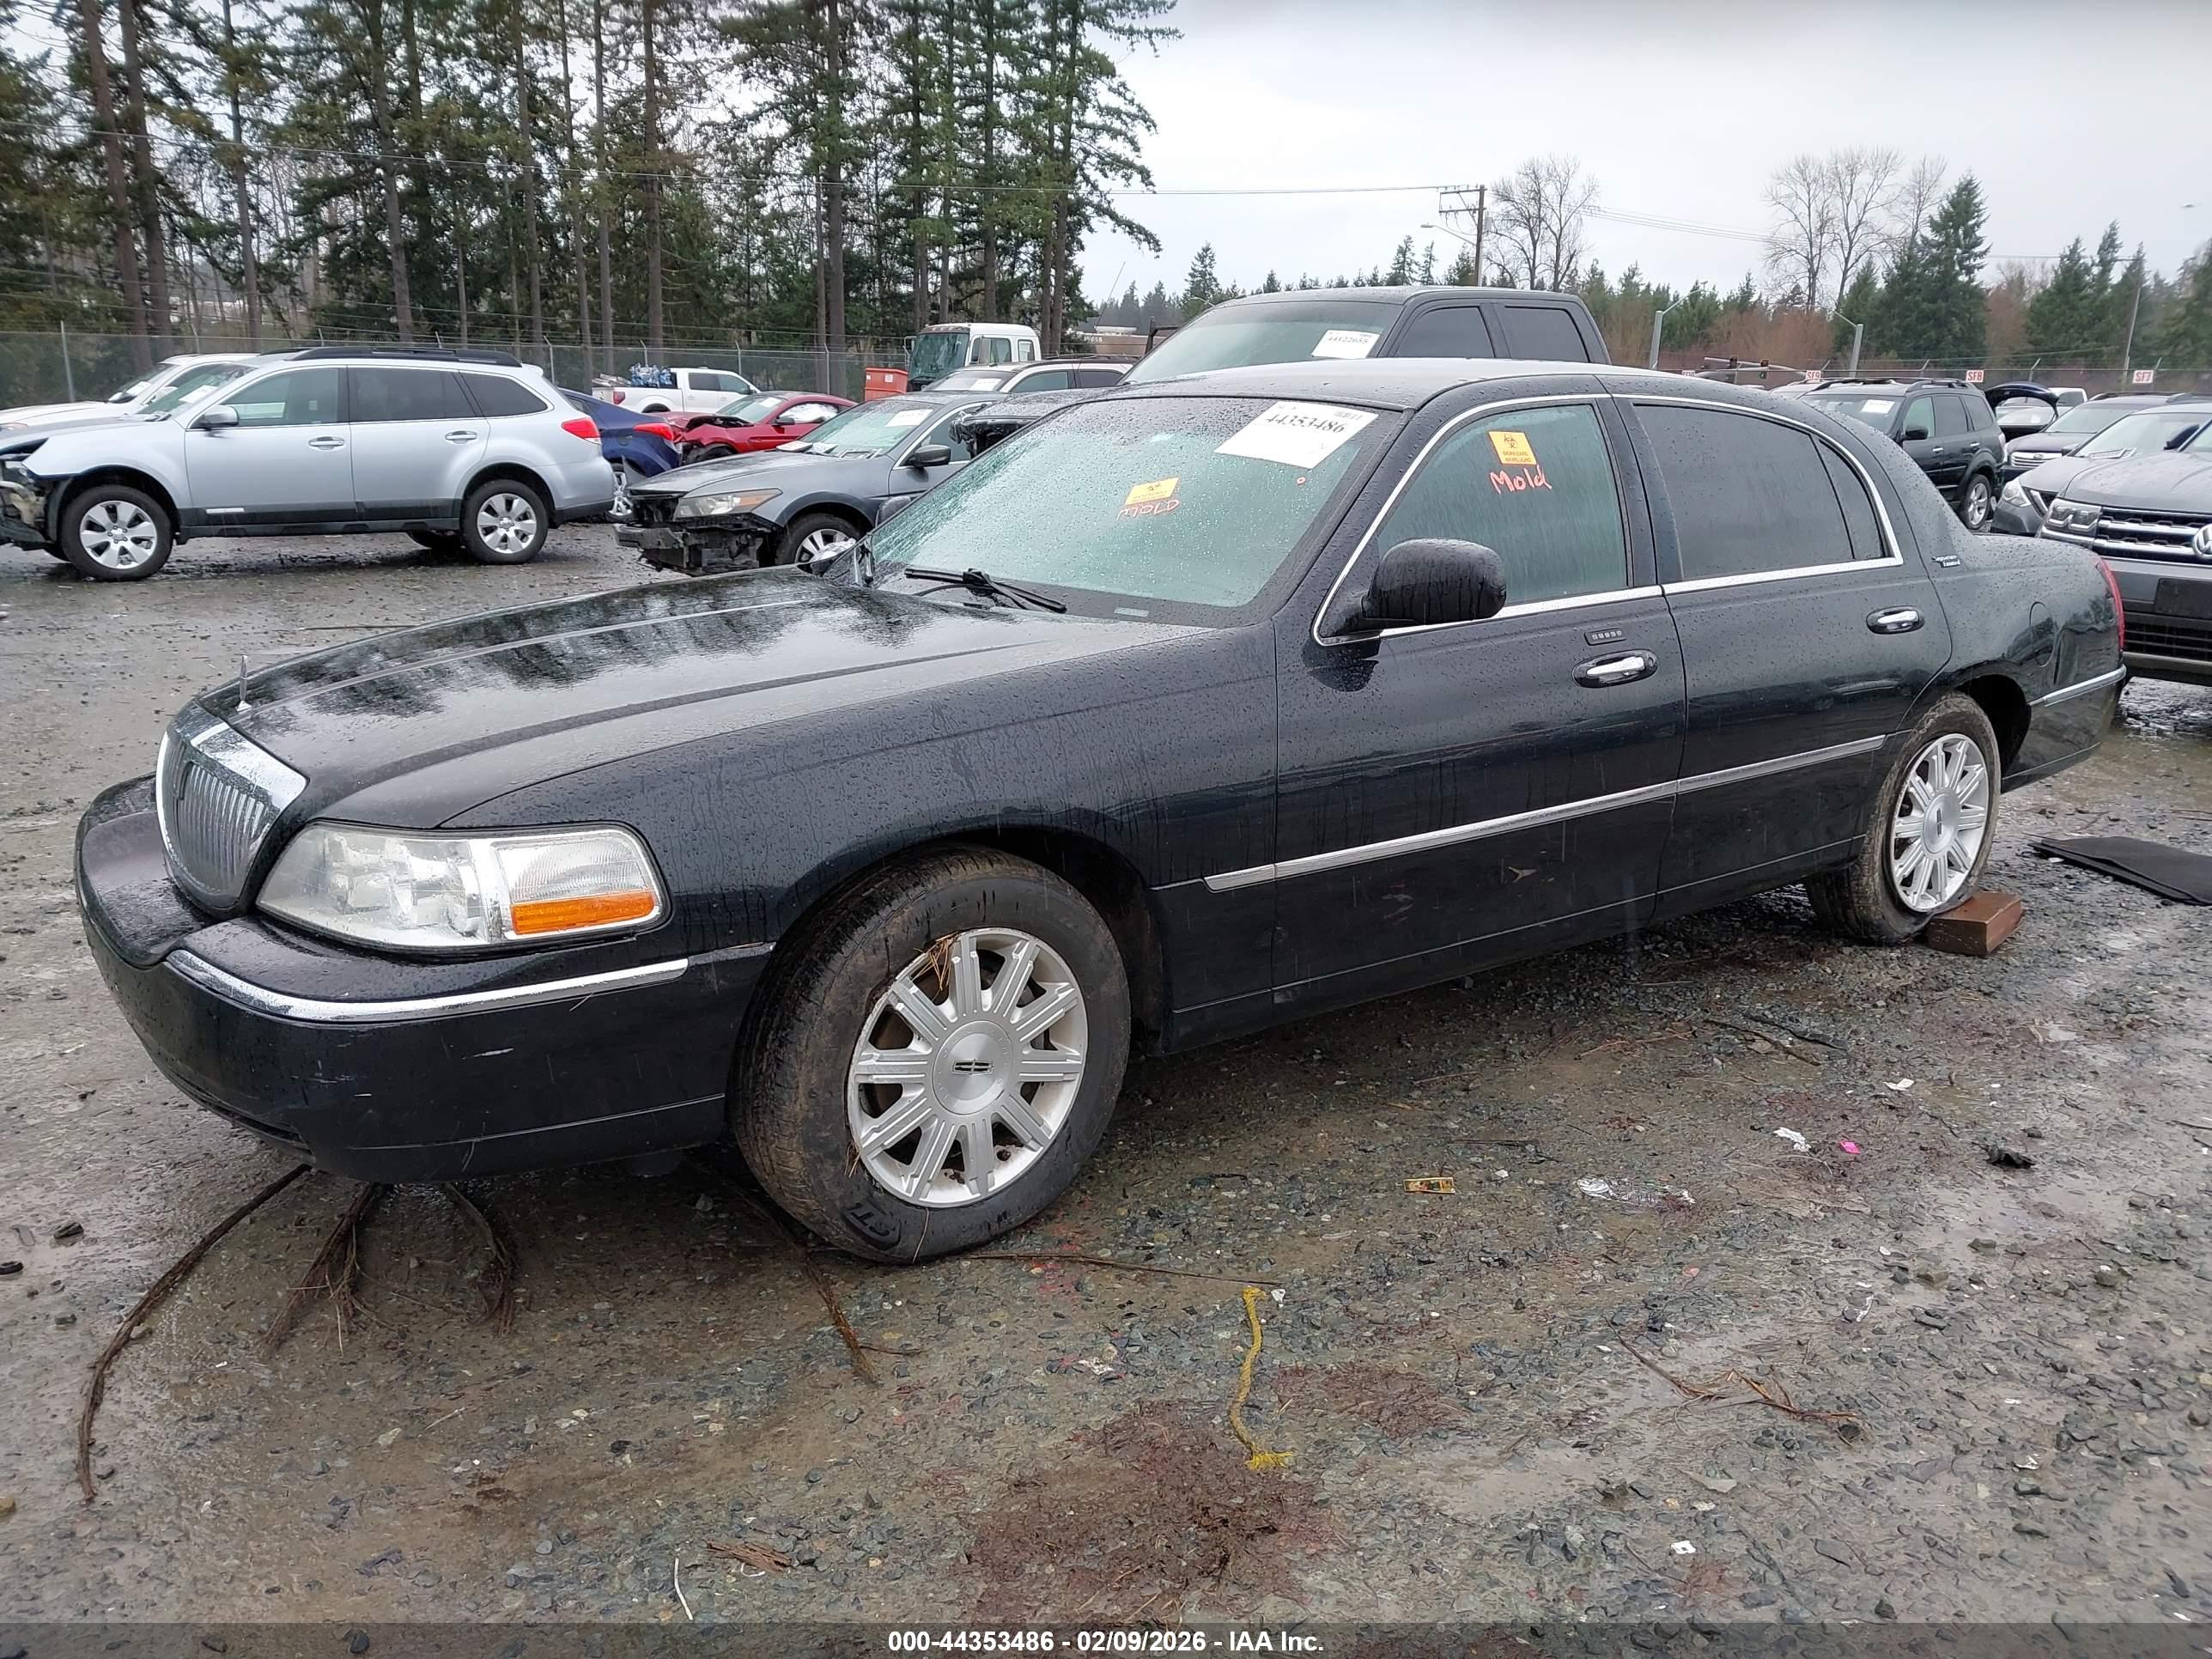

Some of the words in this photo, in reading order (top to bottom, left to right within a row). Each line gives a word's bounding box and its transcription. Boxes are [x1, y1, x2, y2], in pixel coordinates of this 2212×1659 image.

[1967, 371, 1983, 381] SF8
[2135, 372, 2153, 382] SF7
[1266, 413, 1348, 433] 44353486
[1490, 464, 1553, 495] Mold
